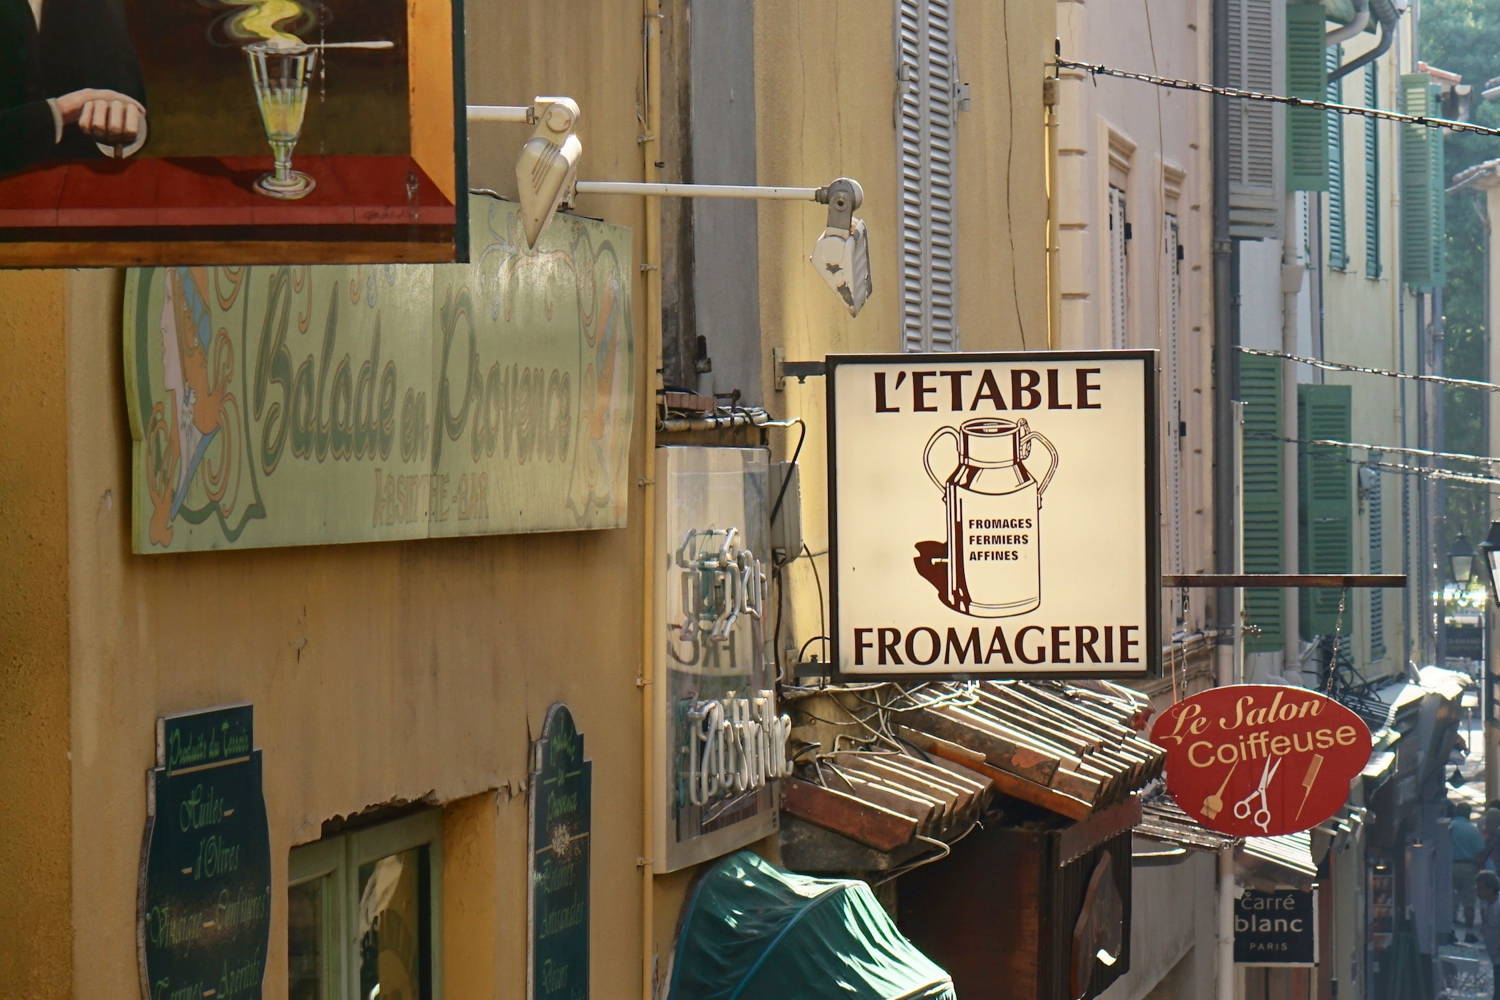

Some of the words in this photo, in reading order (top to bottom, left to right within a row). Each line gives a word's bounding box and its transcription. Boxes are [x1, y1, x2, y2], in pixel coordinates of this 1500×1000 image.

[253, 267, 397, 477] Balade
[400, 386, 429, 463] en
[874, 368, 1101, 413] L'ETABLE
[968, 518, 1032, 529] FROMAGES
[969, 534, 1029, 545] FERMIERS
[969, 550, 1019, 561] AFFINES
[854, 624, 1140, 666] FROMAGERIE
[1159, 703, 1212, 745] Le
[1219, 691, 1327, 730] Salon
[1187, 725, 1357, 768] Coiffeuse
[1241, 894, 1296, 911] carré
[1235, 914, 1304, 932] blanc
[1249, 942, 1288, 951] PARIS
